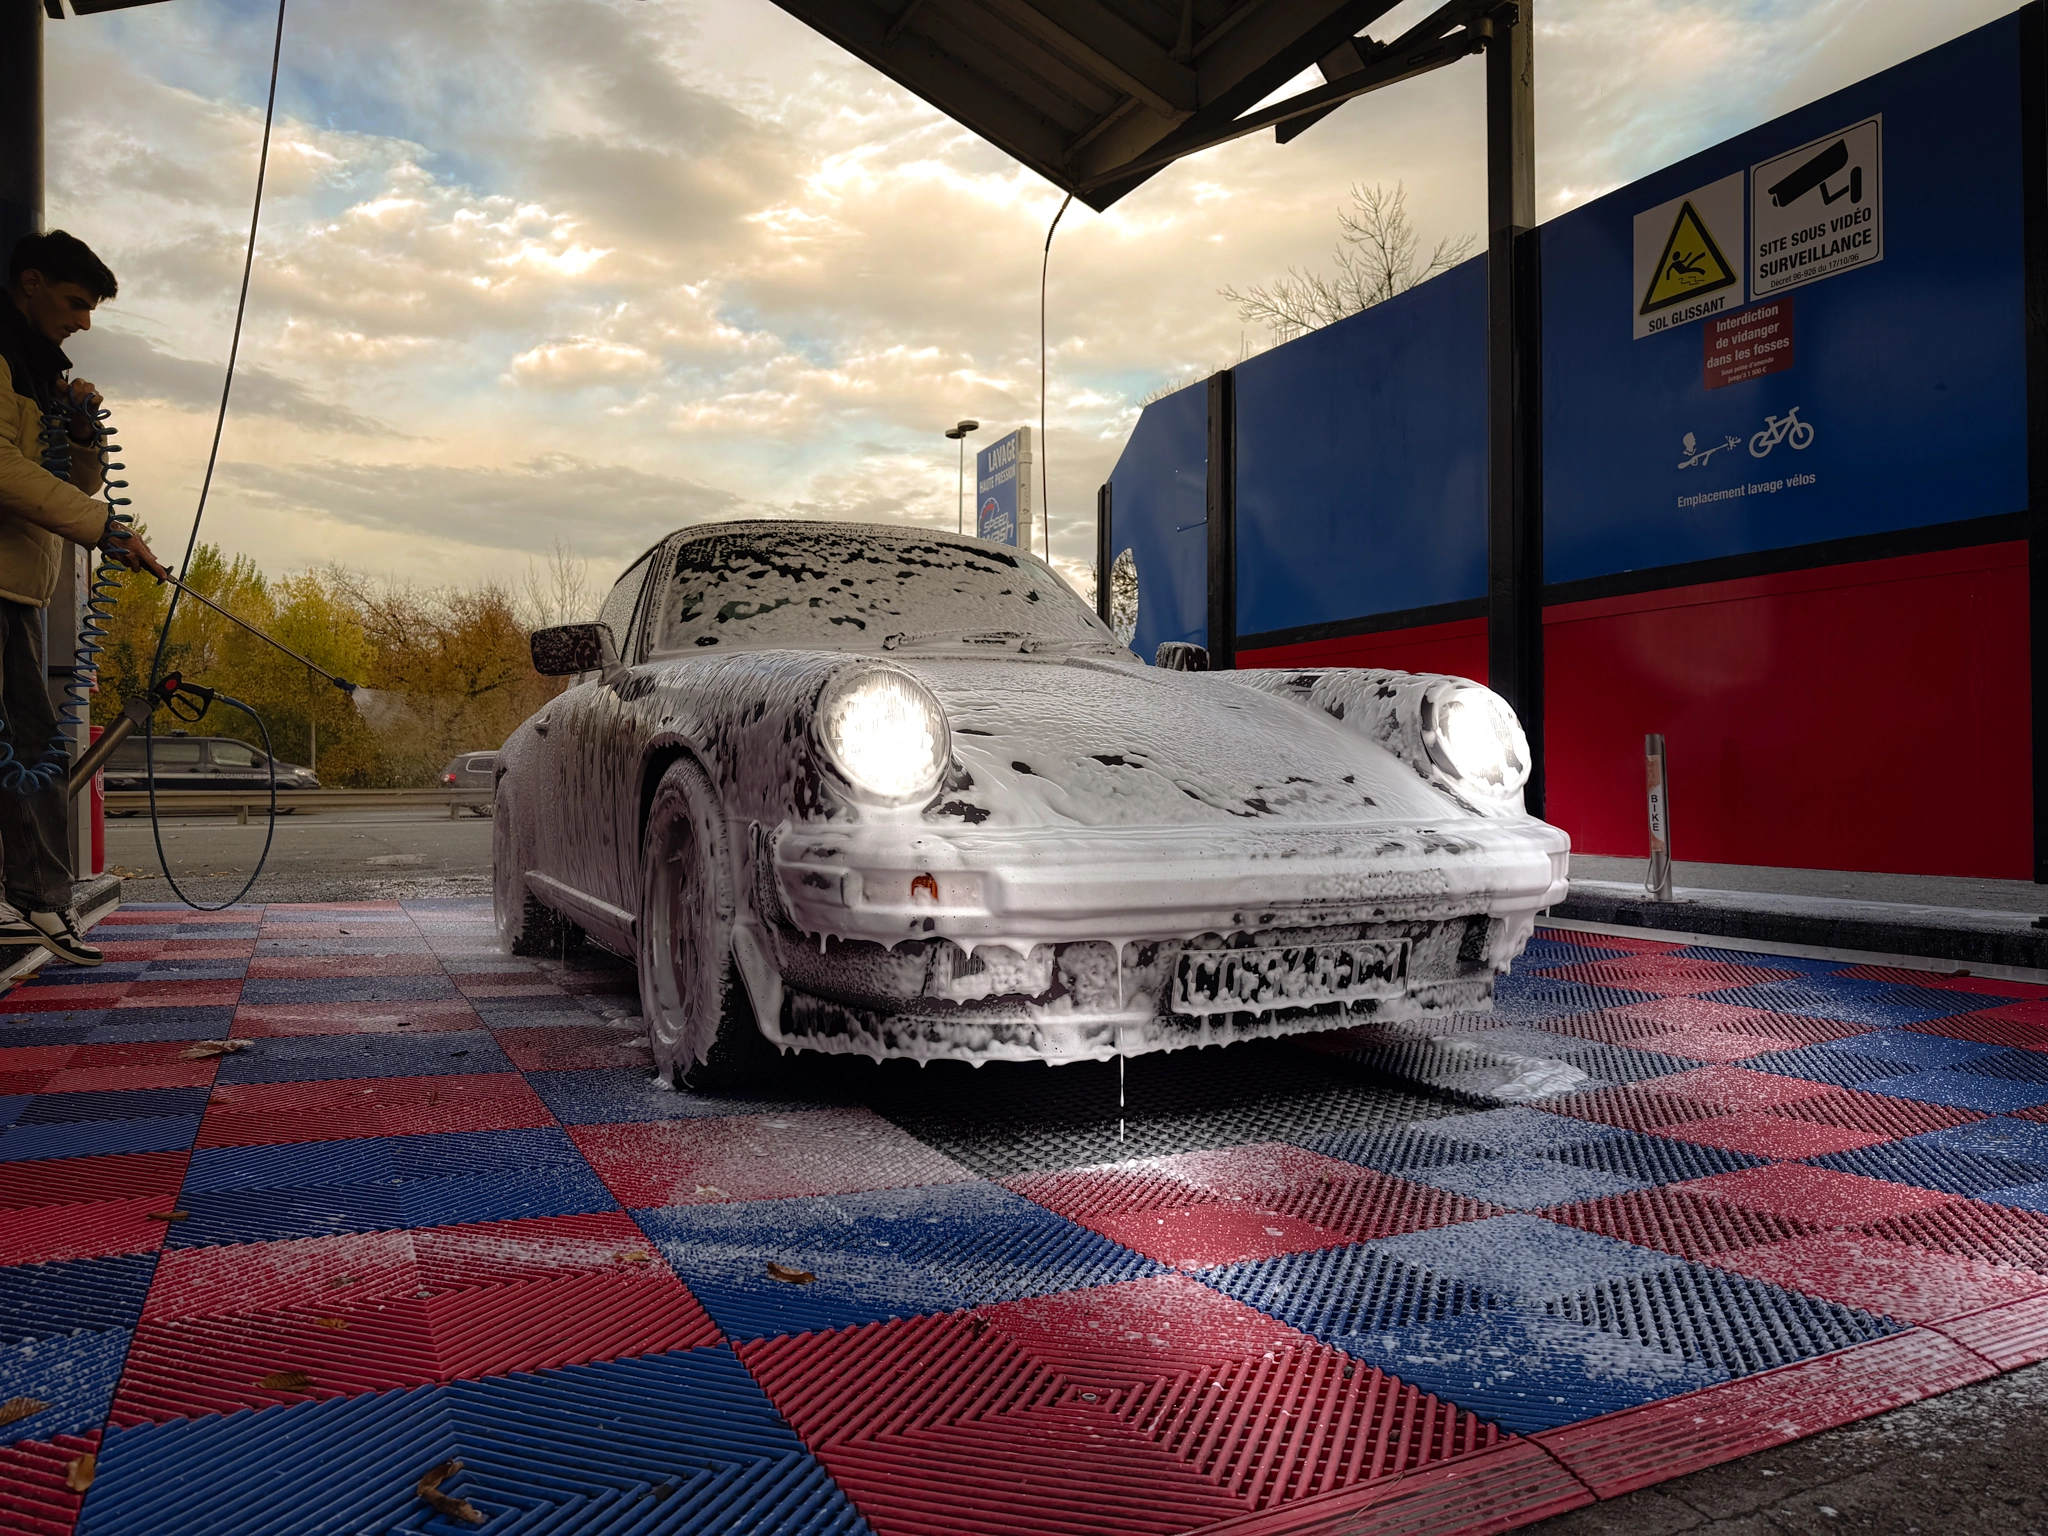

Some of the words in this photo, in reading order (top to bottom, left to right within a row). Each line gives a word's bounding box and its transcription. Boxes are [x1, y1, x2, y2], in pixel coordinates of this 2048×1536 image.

[1760, 237, 1787, 257] SITE
[1791, 223, 1826, 246] SOUS
[1830, 207, 1872, 233] VIDÉO
[1760, 227, 1873, 279] SURVEILLANCE
[1770, 275, 1792, 288] Décret
[1793, 267, 1817, 281] 96-926
[1818, 264, 1827, 273] du
[1828, 253, 1859, 269] 17/10/96
[1649, 316, 1668, 332] SOL
[1671, 296, 1725, 324] GLISSANT
[1716, 305, 1779, 333] Interdiction
[1706, 353, 1732, 369] dans
[1734, 347, 1751, 361] les
[1753, 337, 1790, 356] fosses
[1715, 337, 1729, 350] de
[1731, 322, 1780, 345] vidanger
[988, 438, 1016, 472] LAVAGE
[979, 476, 994, 494] HAUTE
[994, 464, 1016, 486] PRESSION
[1677, 484, 1746, 508] Emplacement
[1748, 480, 1784, 495] lavage
[1786, 473, 1816, 488] vélos
[1651, 794, 1659, 832] BIKE
